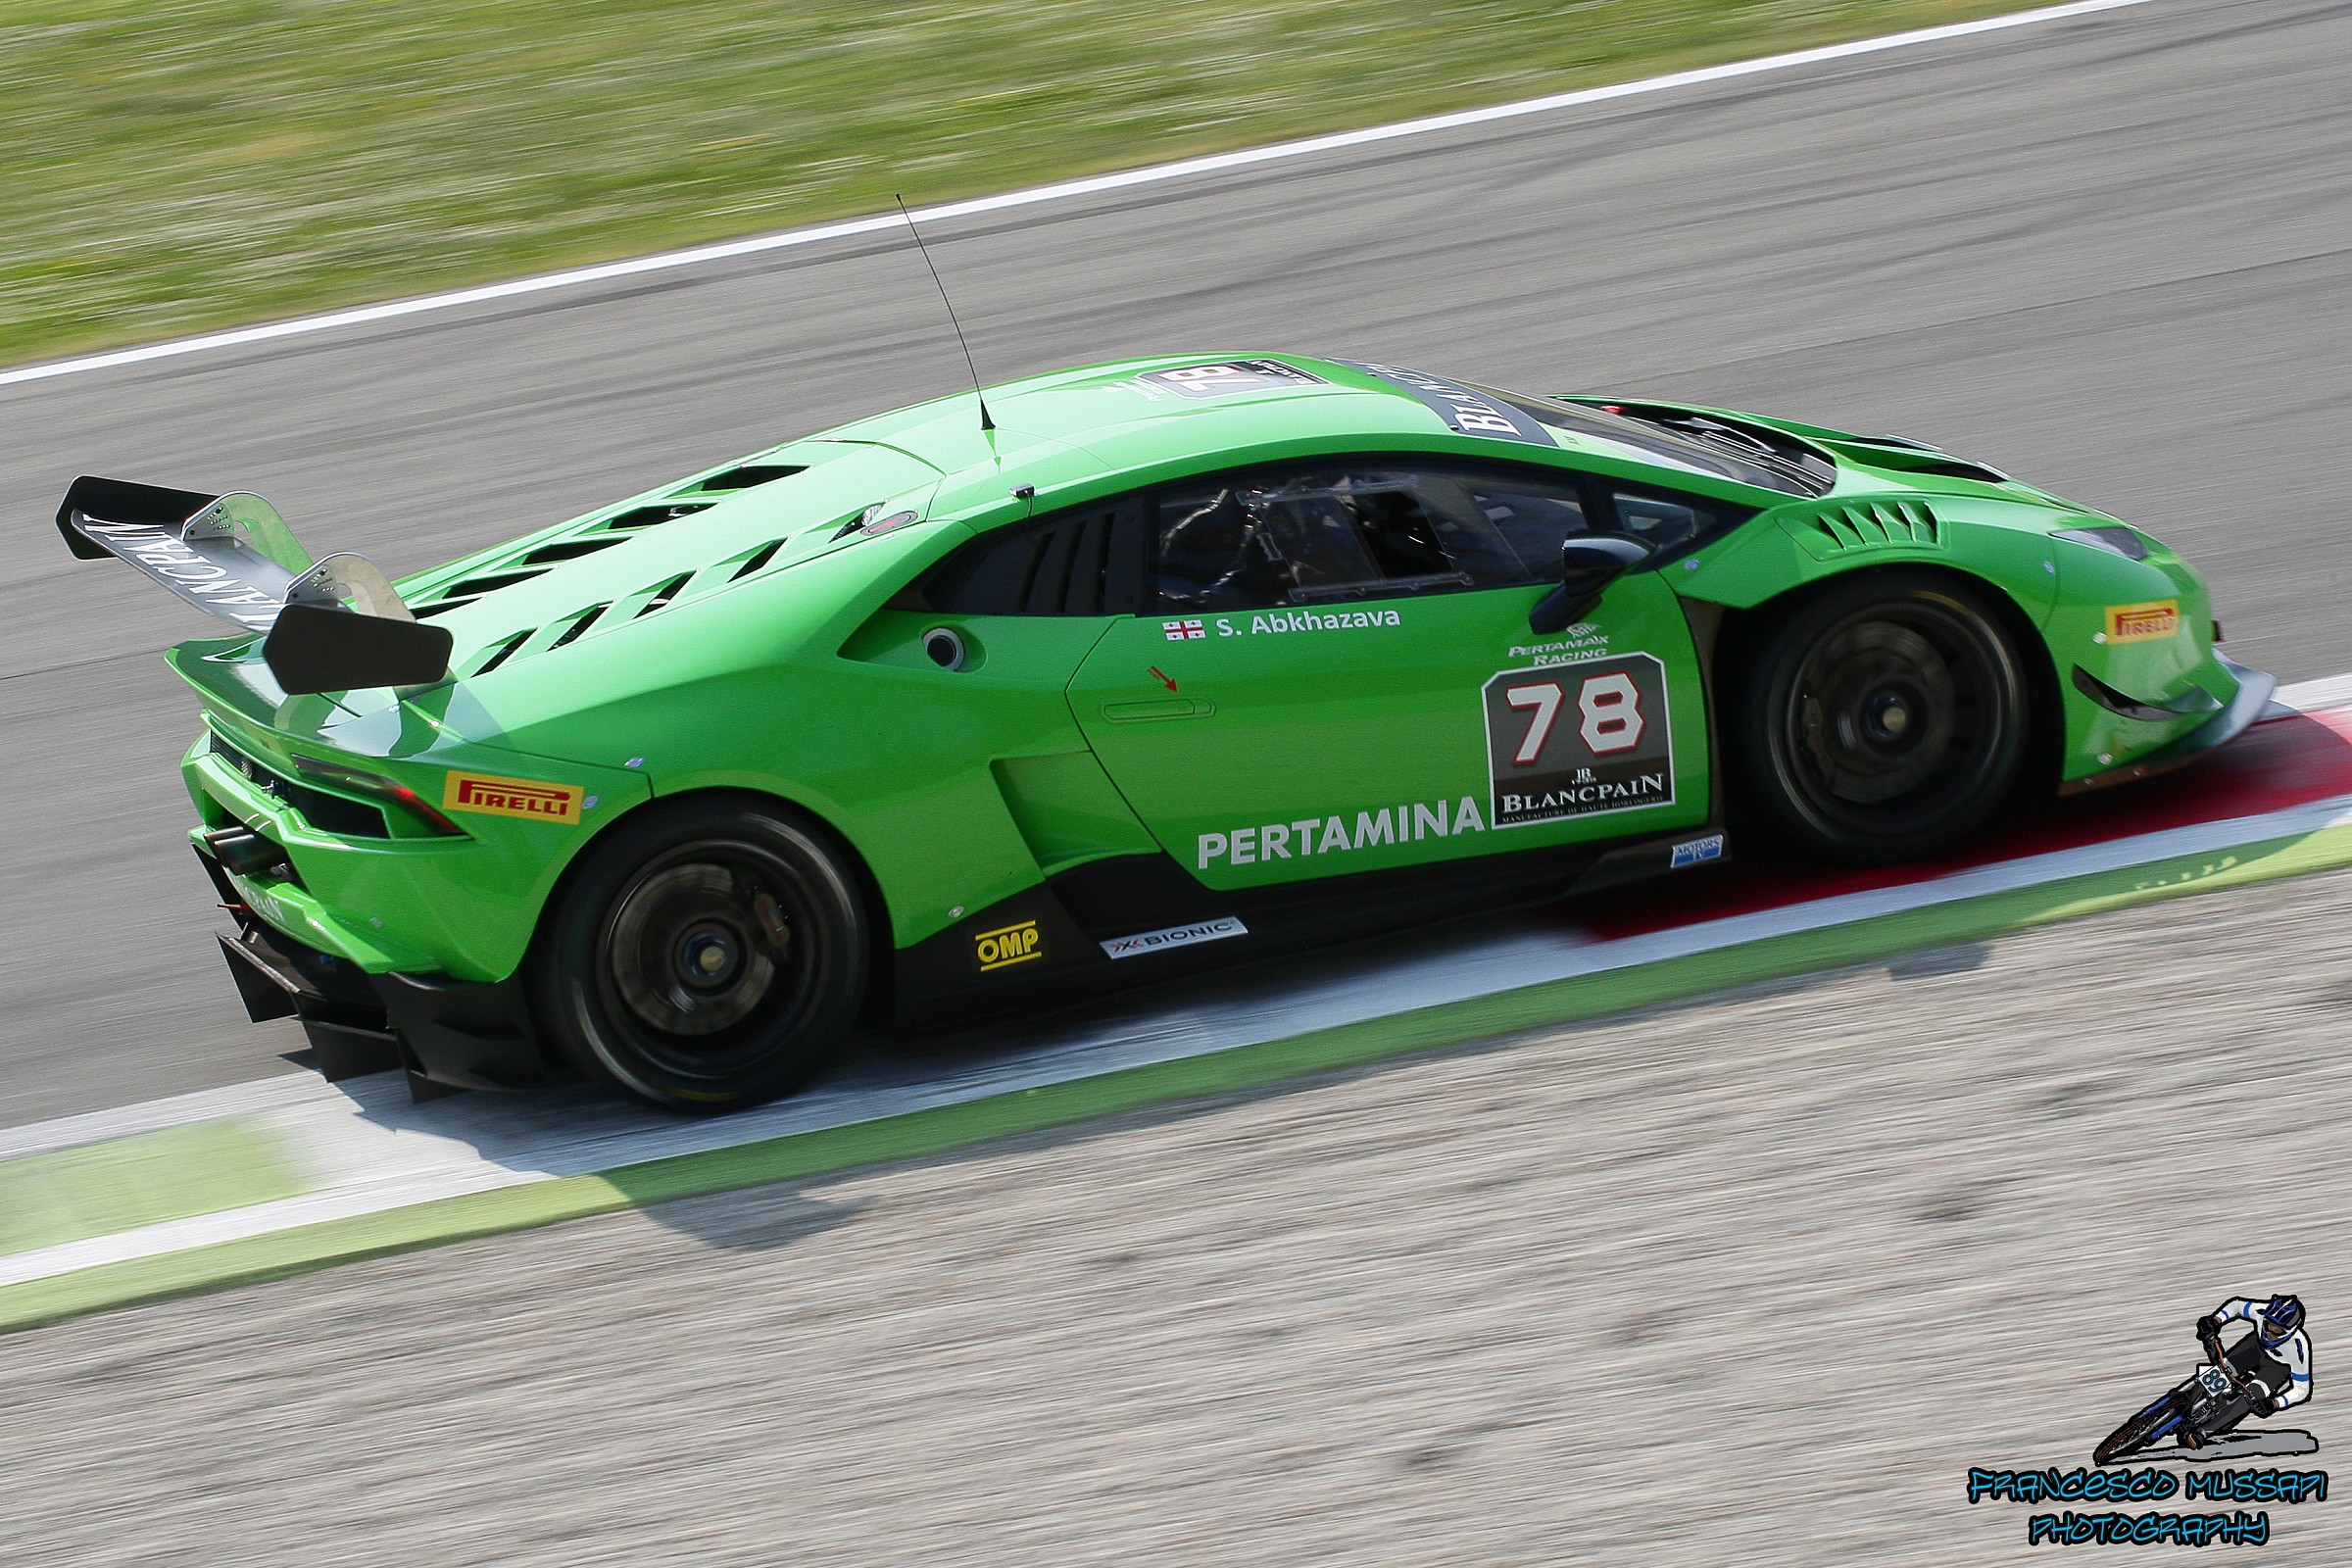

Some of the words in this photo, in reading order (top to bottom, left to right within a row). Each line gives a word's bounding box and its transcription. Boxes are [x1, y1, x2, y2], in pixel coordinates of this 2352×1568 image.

[82, 514, 287, 630] LANCPAIN
[1215, 618, 1243, 637] S.
[1251, 610, 1401, 635] Abkhazava
[2115, 607, 2175, 637] PIRELLI
[1533, 648, 1607, 666] RACING
[1506, 669, 1647, 766] 78
[458, 779, 571, 816] PIRELLI
[1500, 772, 1664, 814] BLANCPAIN
[1198, 796, 1486, 870] PERTAMINA
[977, 927, 1039, 963] OMP
